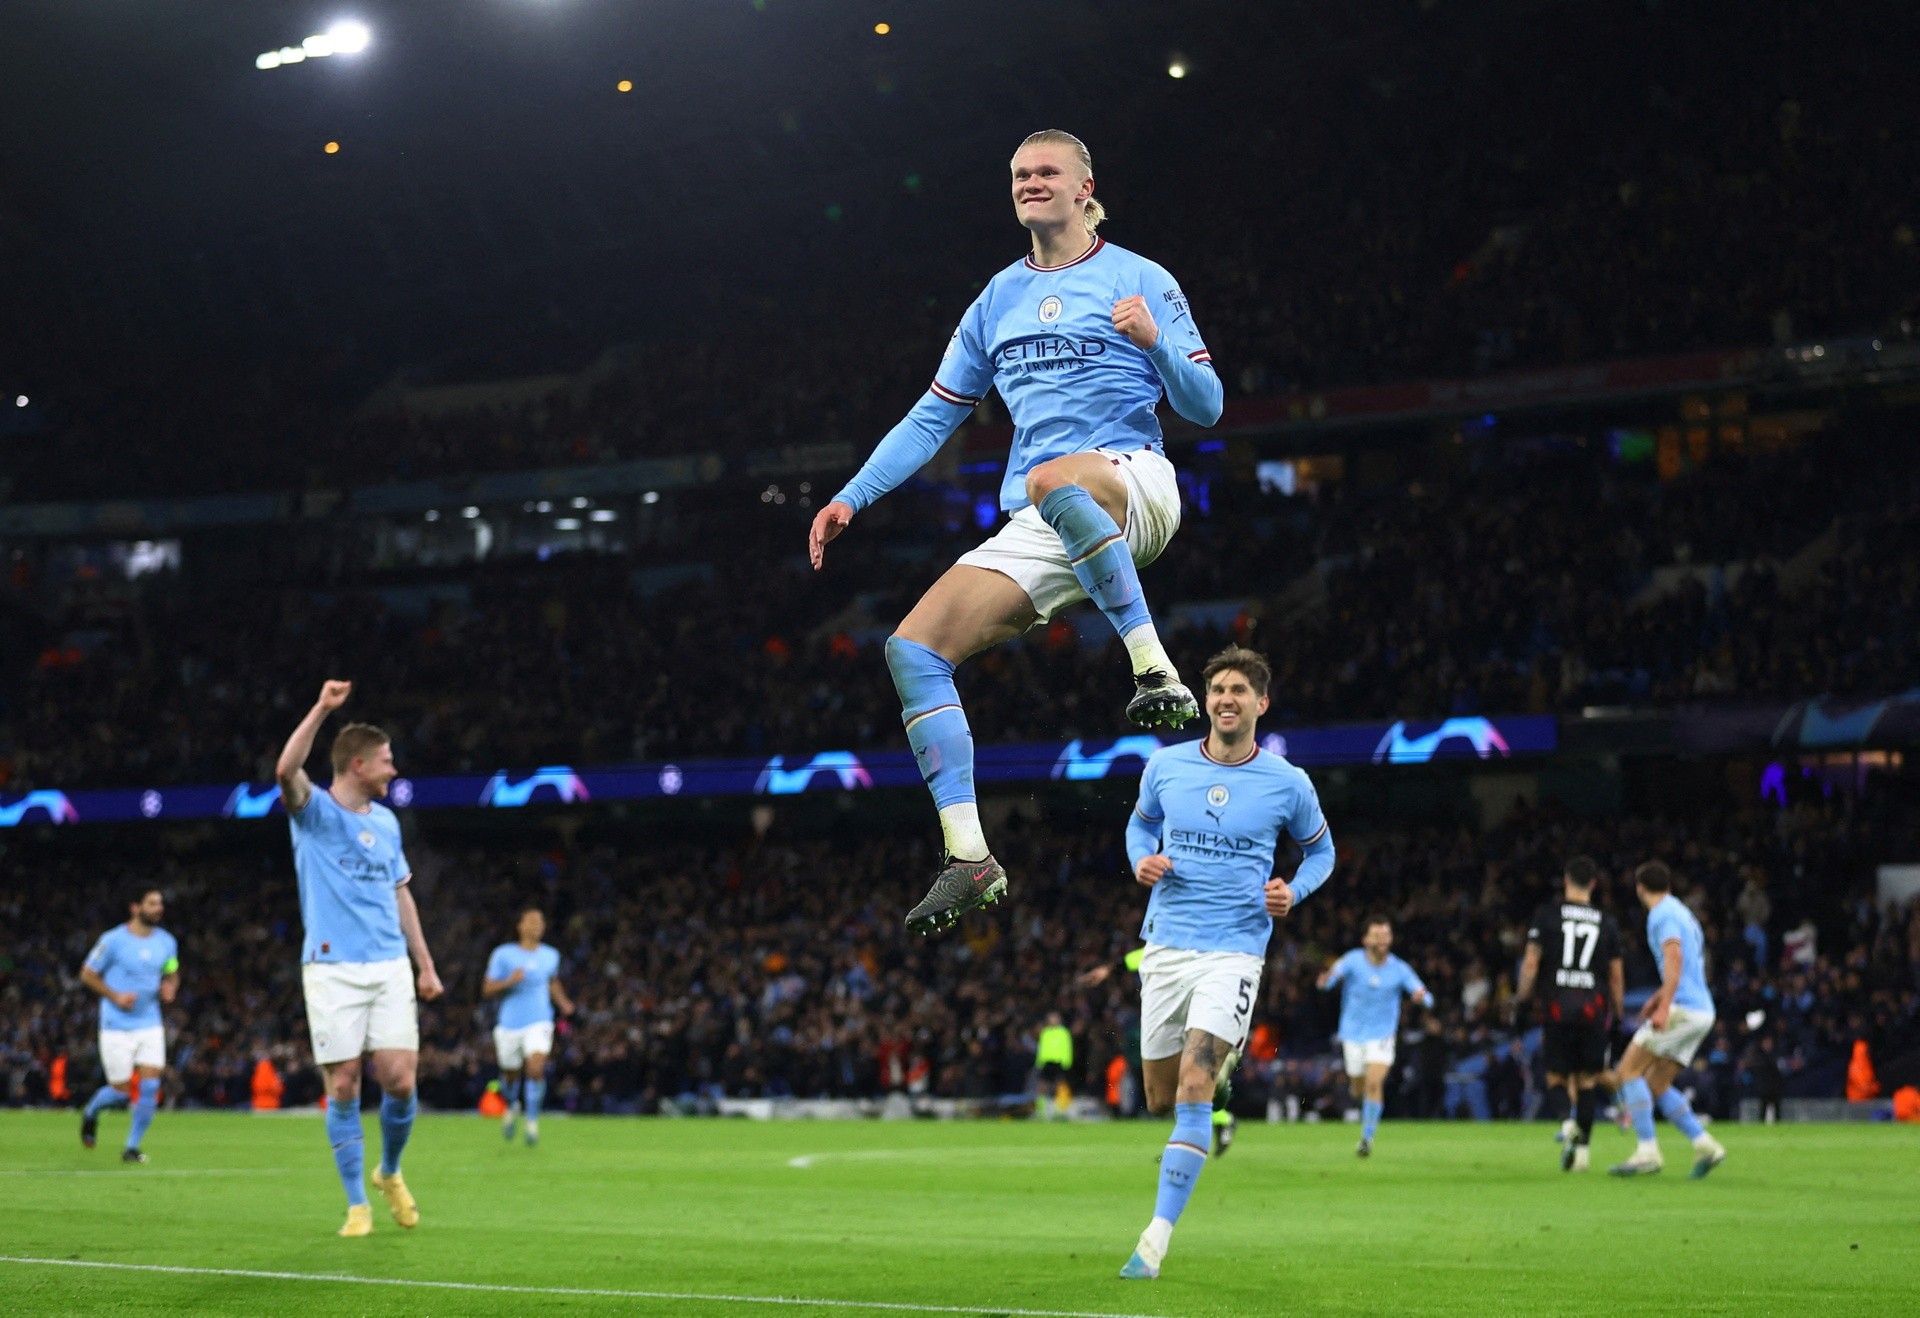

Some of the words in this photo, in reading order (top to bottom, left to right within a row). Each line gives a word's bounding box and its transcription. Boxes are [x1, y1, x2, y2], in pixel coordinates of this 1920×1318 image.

[1003, 339, 1106, 361] ETIHAD
[1018, 360, 1085, 374] AIRWAYS
[1088, 574, 1115, 594] CITY
[1170, 829, 1253, 851] ETIHAD
[1561, 920, 1600, 970] 17
[1235, 978, 1252, 1016] 5
